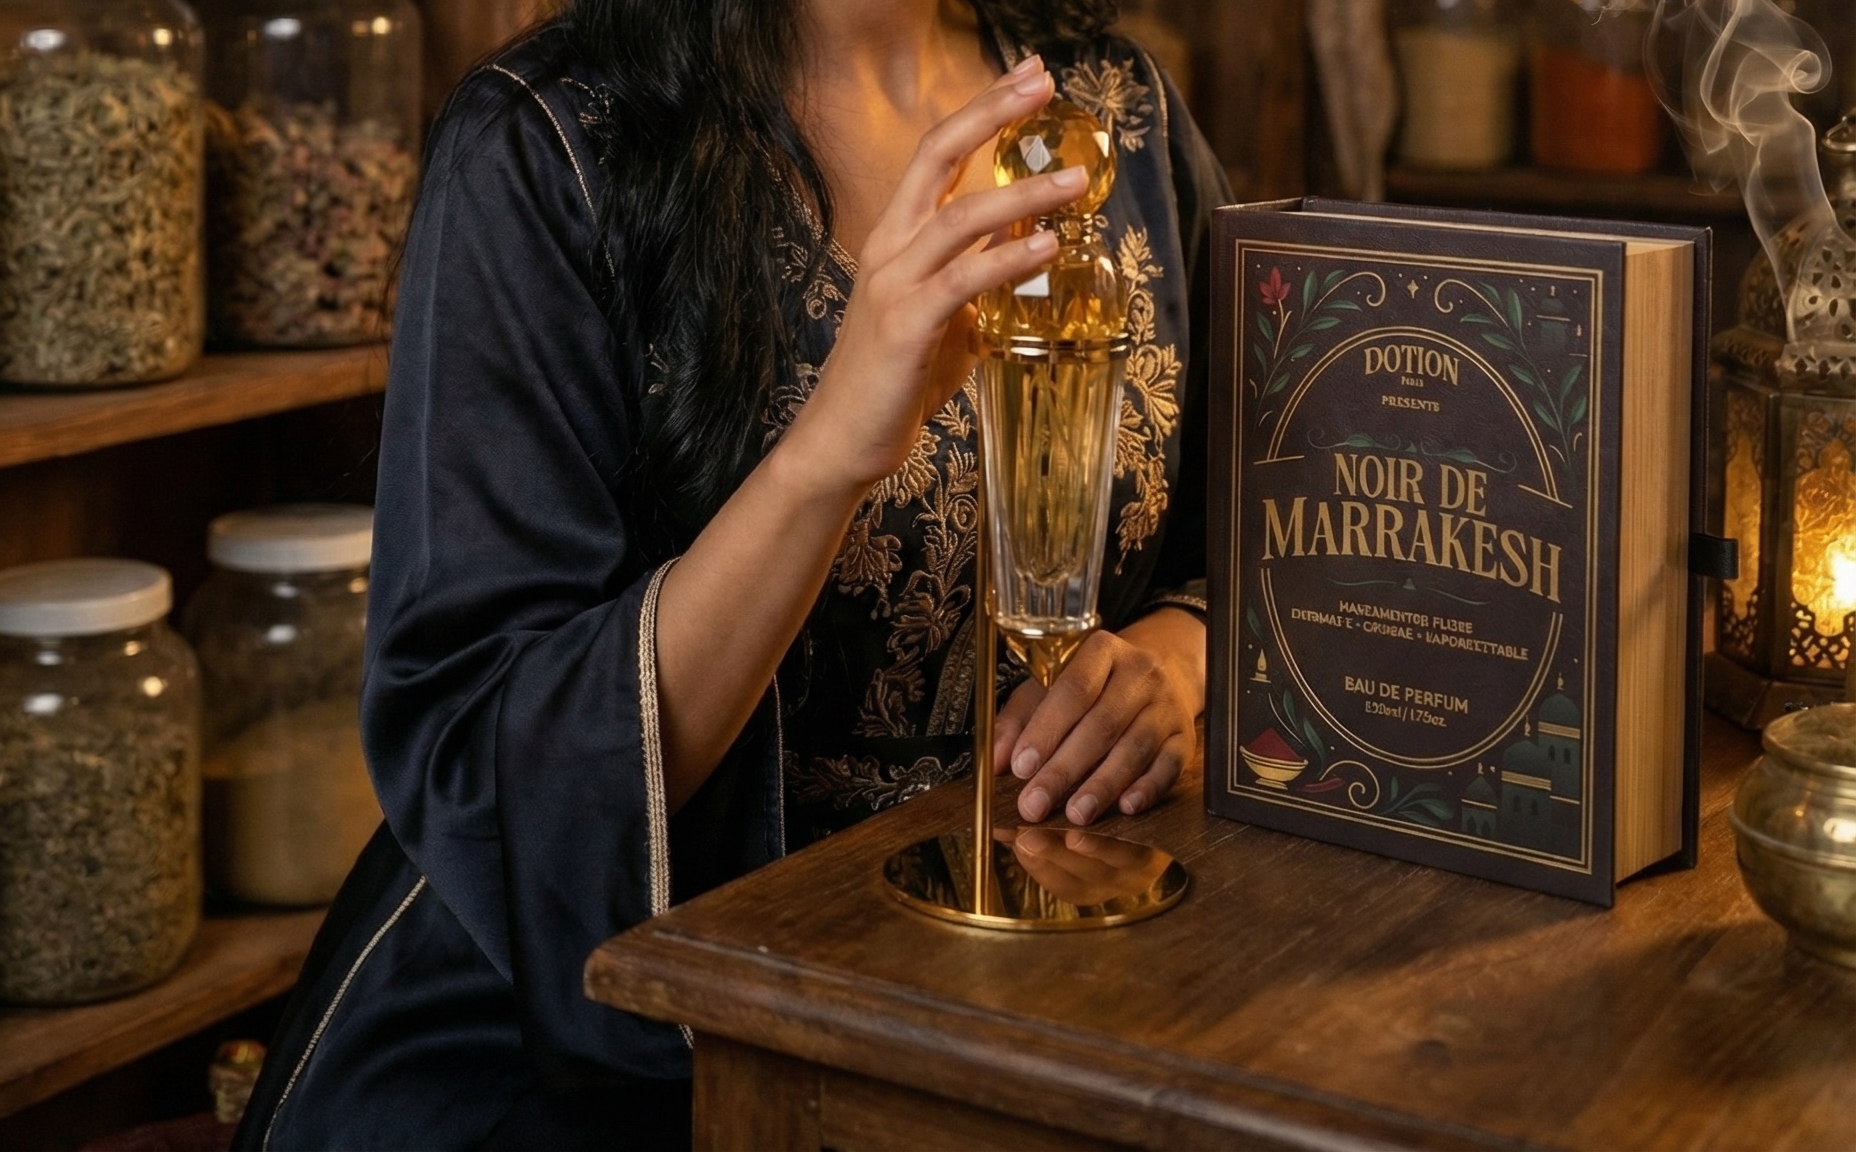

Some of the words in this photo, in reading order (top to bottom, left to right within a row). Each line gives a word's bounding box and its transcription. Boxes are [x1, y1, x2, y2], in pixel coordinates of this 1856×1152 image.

[1364, 344, 1460, 386] DOTION
[1333, 453, 1426, 505] NOIR
[1439, 463, 1488, 517] DE
[1262, 496, 1562, 604] MARRAKESH
[1344, 676, 1375, 695] EAU
[1379, 682, 1401, 700] DE
[1405, 687, 1468, 714] PERFUM
